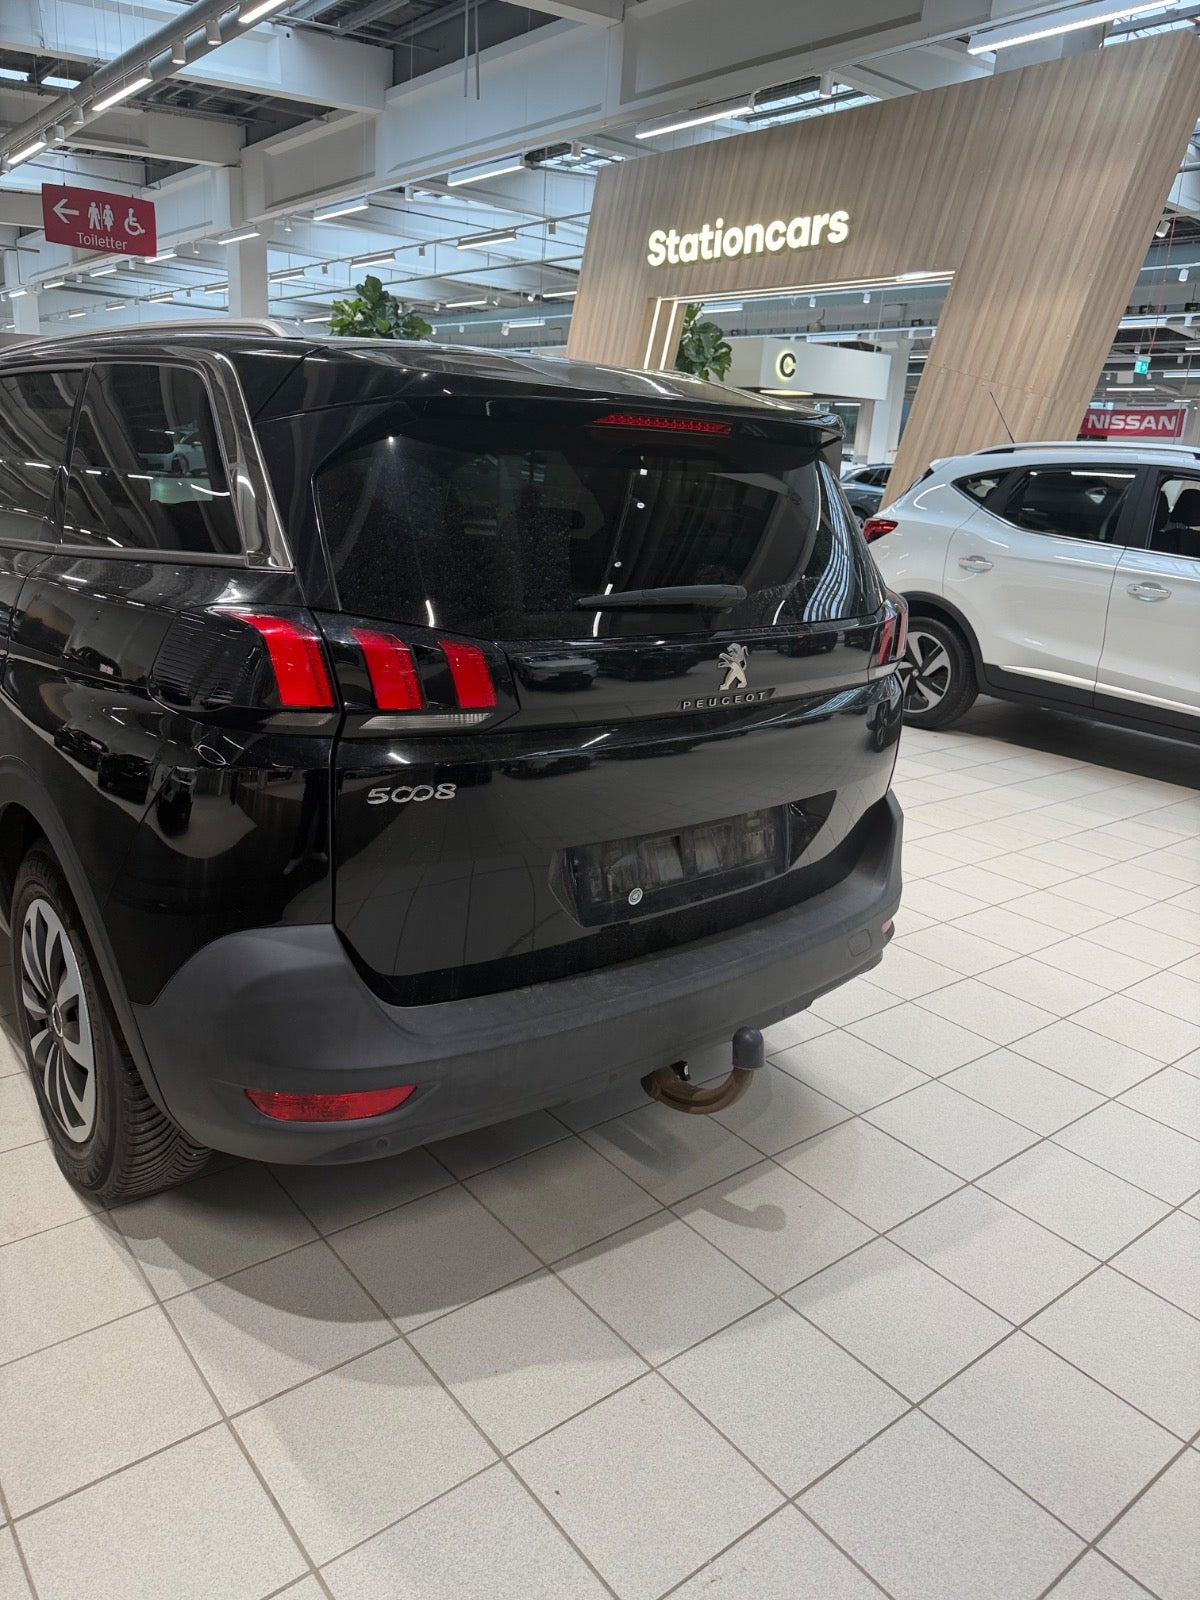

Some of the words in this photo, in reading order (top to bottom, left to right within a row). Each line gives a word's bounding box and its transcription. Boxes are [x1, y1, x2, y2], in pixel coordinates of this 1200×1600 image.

[76, 231, 127, 250] Toiletter
[647, 210, 849, 266] Stationcars
[1087, 414, 1177, 430] NISSAN
[682, 691, 766, 709] PEUGEOT
[367, 783, 457, 804] 5008
